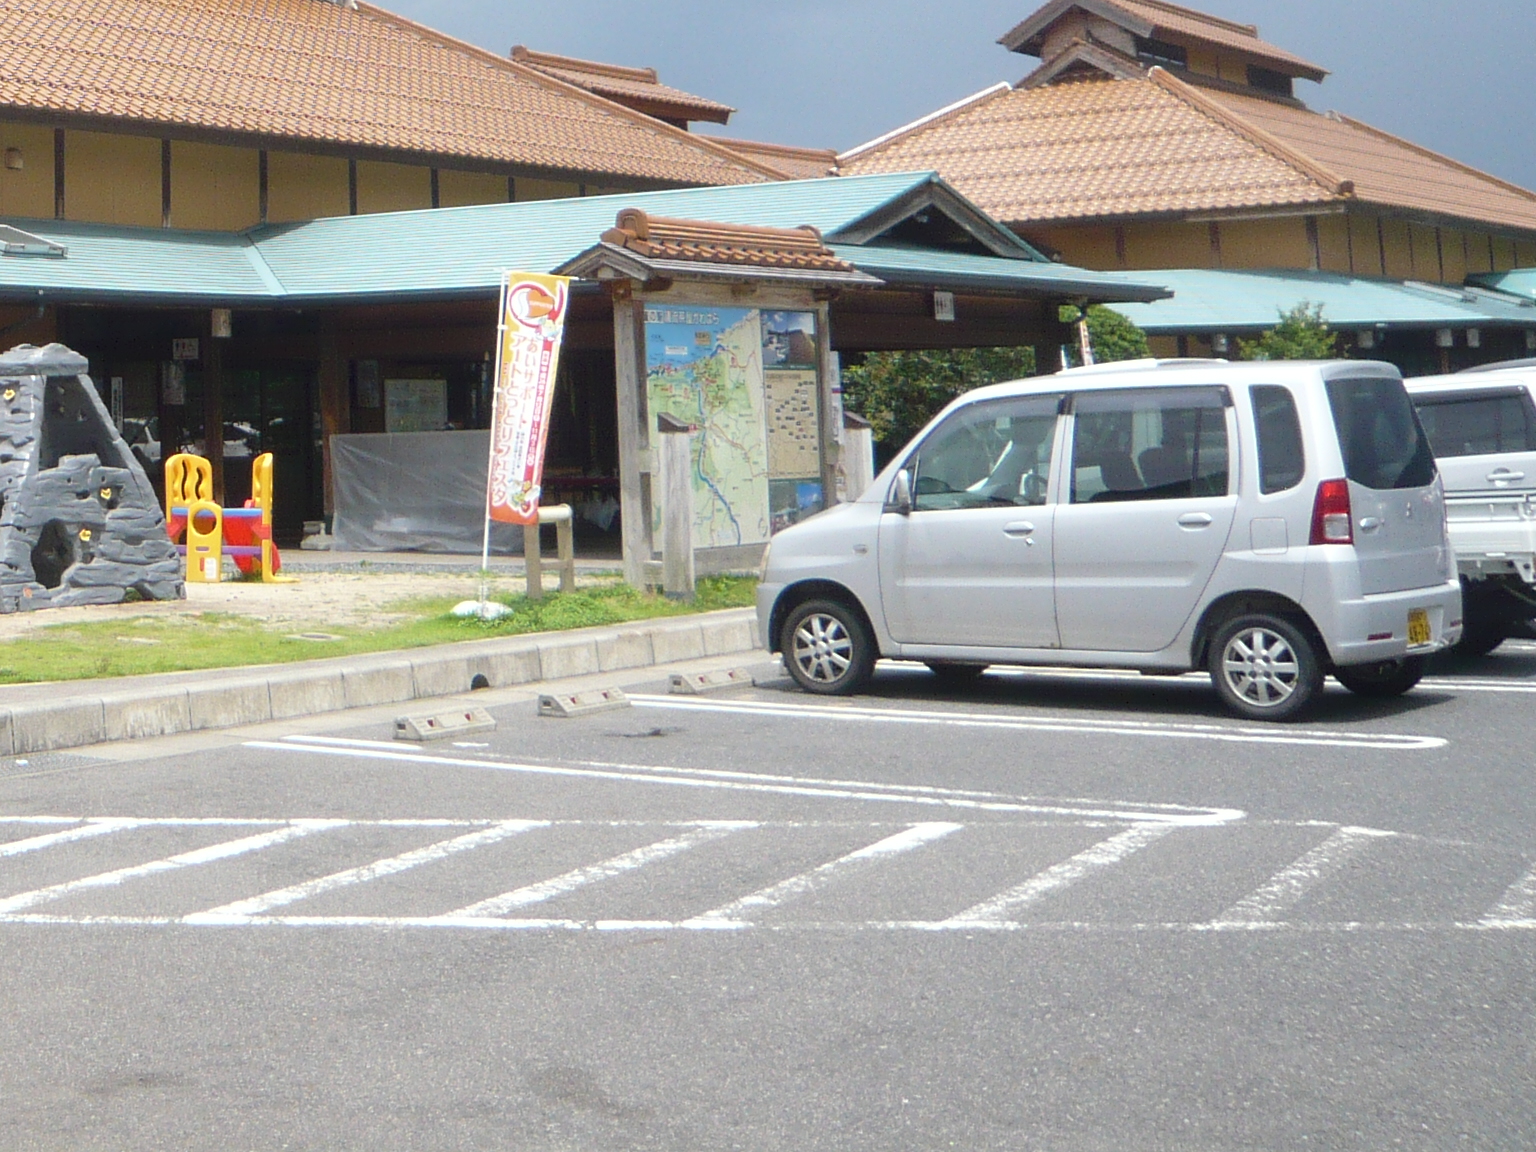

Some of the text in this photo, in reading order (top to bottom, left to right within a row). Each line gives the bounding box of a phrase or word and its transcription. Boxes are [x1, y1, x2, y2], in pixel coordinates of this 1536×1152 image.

[492, 333, 526, 505] アートとっとりフェスタ
